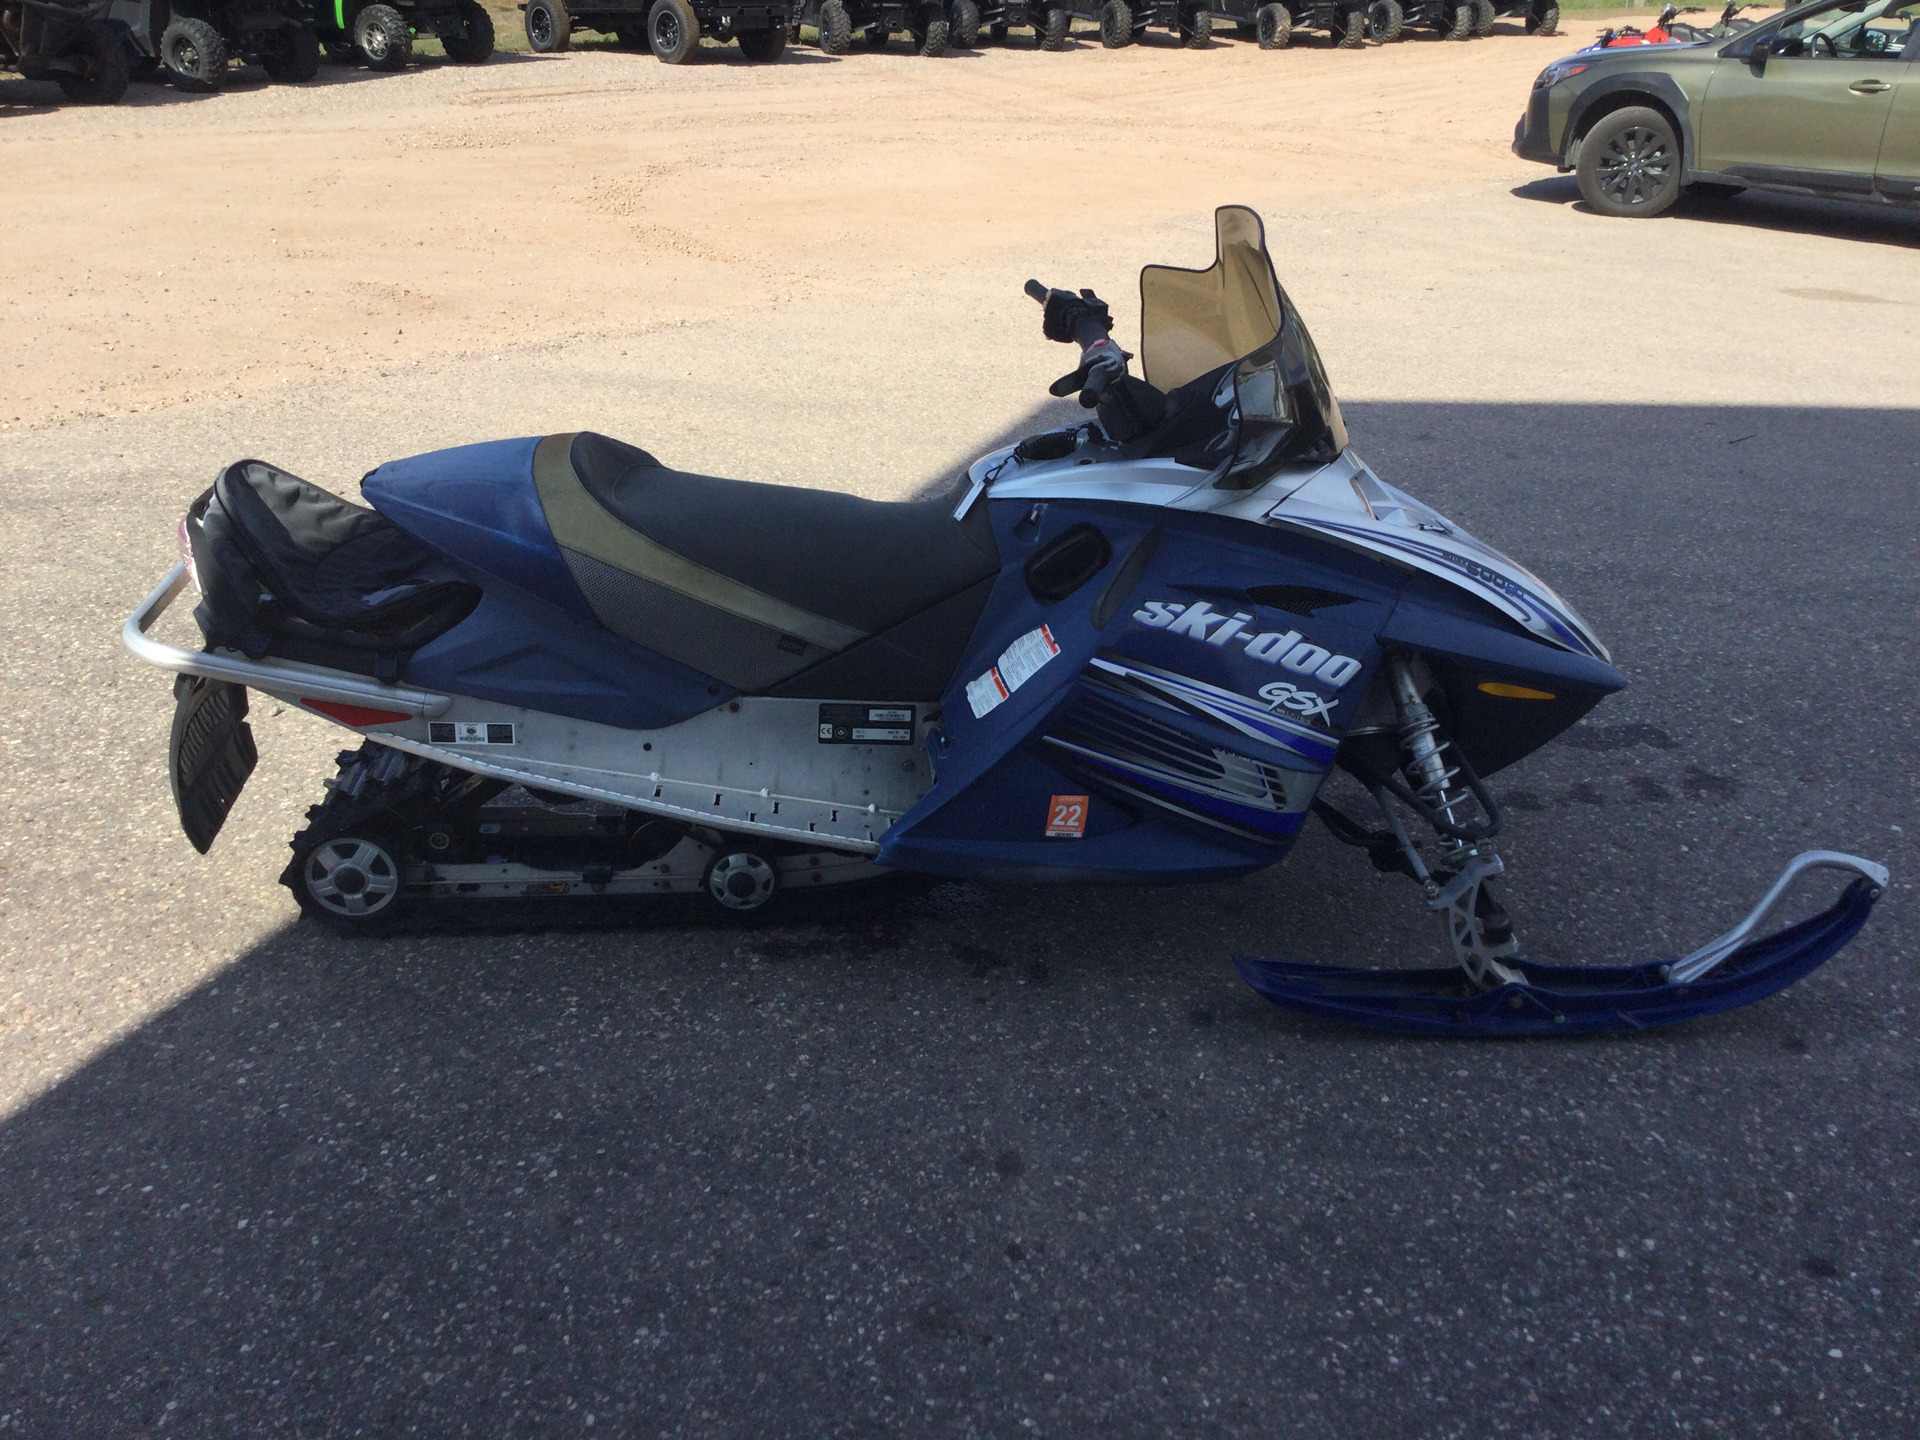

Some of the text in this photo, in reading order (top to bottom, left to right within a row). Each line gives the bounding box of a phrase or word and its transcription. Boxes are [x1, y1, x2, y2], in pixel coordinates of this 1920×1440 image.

[1132, 601, 1363, 687] ski-doo
[1259, 682, 1339, 727] GSX
[1052, 805, 1081, 826] 22
